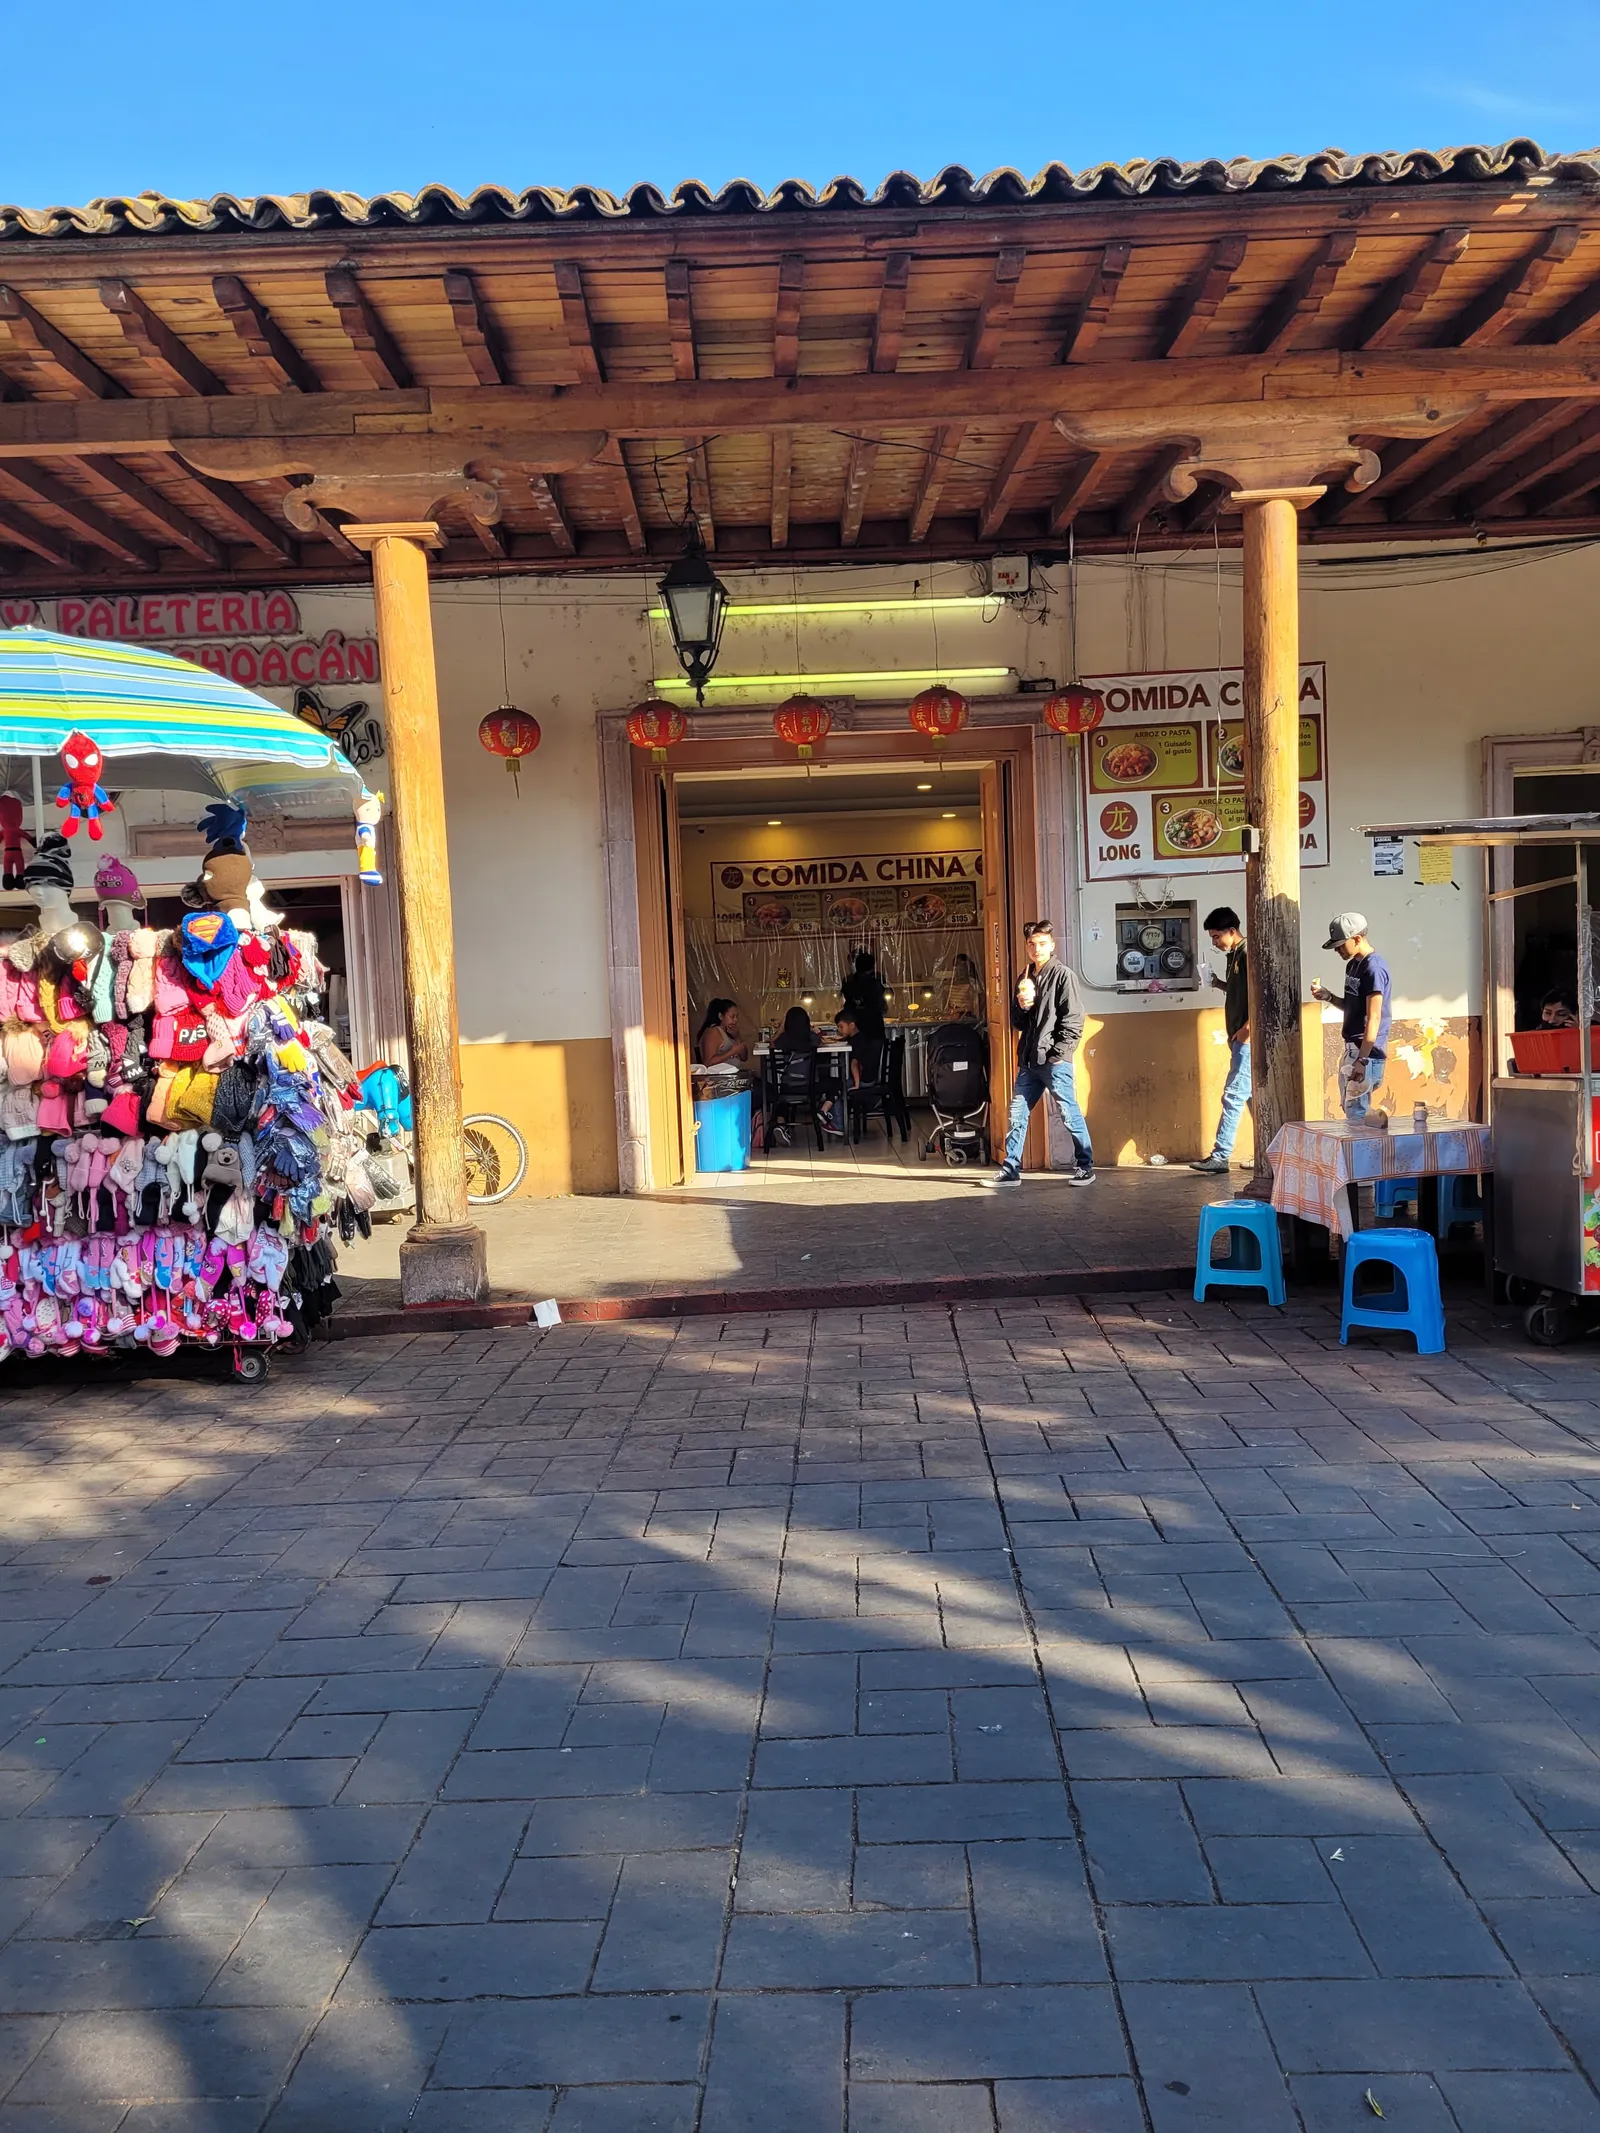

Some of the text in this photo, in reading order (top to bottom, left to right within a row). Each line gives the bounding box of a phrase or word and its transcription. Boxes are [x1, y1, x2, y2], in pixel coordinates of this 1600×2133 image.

[62, 596, 293, 637] PALETERIA
[1169, 728, 1191, 736] PASTA
[1098, 736, 1104, 746] 1
[1164, 740, 1191, 748] Guisado
[1172, 748, 1191, 756] gusto
[1198, 797, 1222, 805] ARROZ
[1162, 803, 1170, 813] 3
[1105, 806, 1133, 834] 龙
[1098, 843, 1141, 861] LONG
[752, 856, 967, 887] COMIDA CHINA
[826, 894, 832, 902] 2
[951, 914, 968, 923] $105
